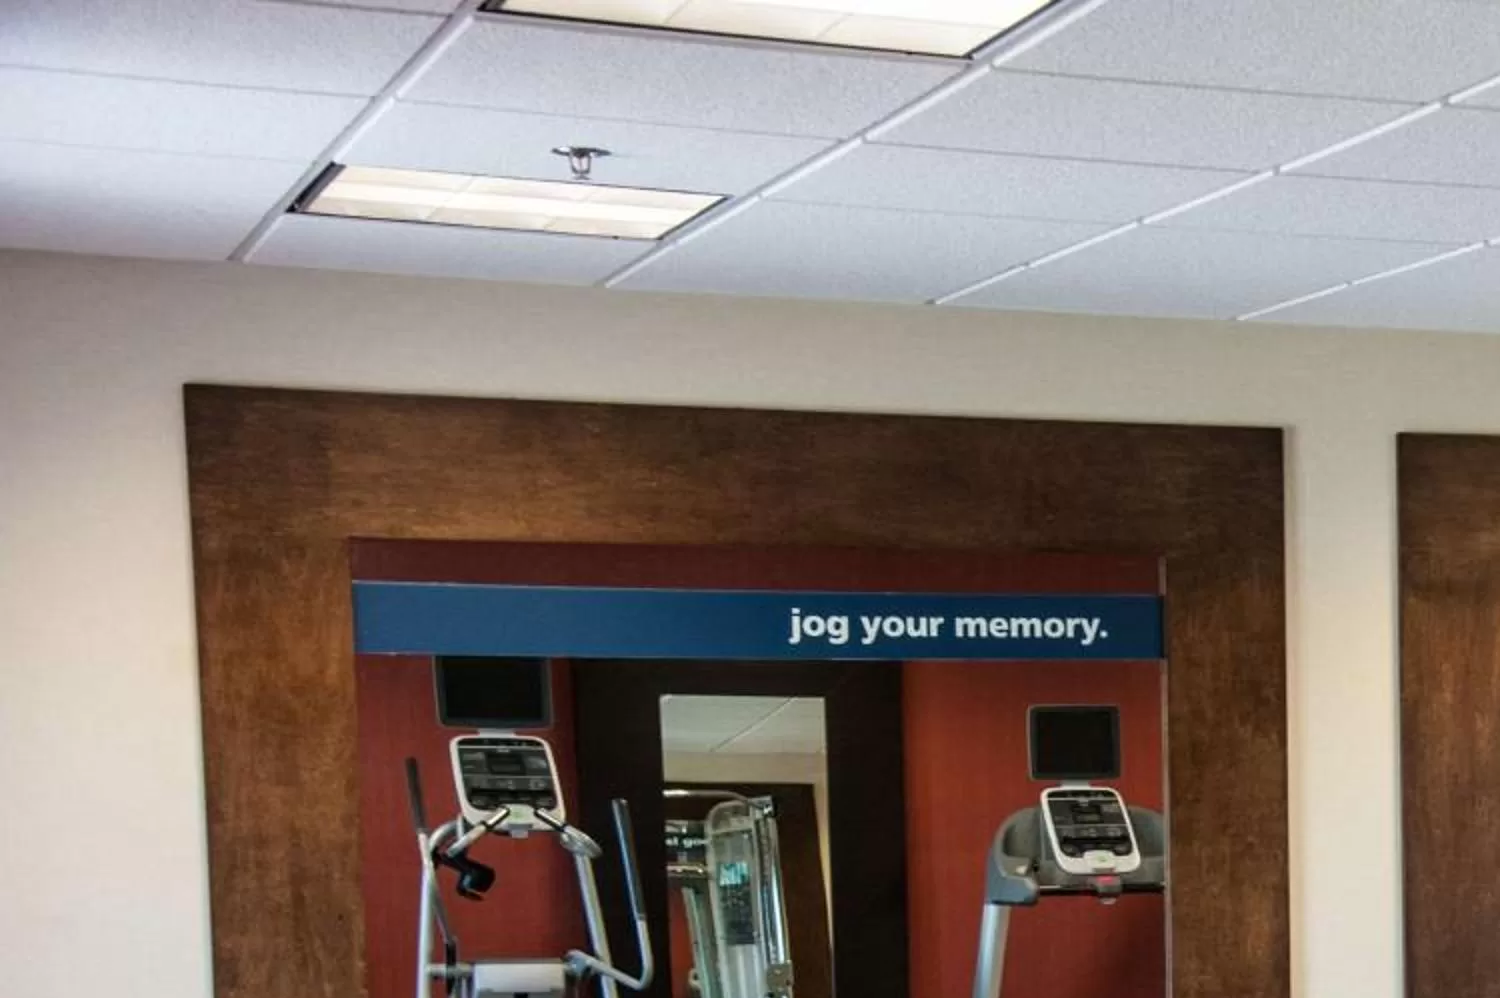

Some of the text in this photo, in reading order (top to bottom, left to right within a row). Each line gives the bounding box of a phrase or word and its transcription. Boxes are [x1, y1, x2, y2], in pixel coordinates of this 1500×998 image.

[788, 607, 1108, 645] jog your memory.
